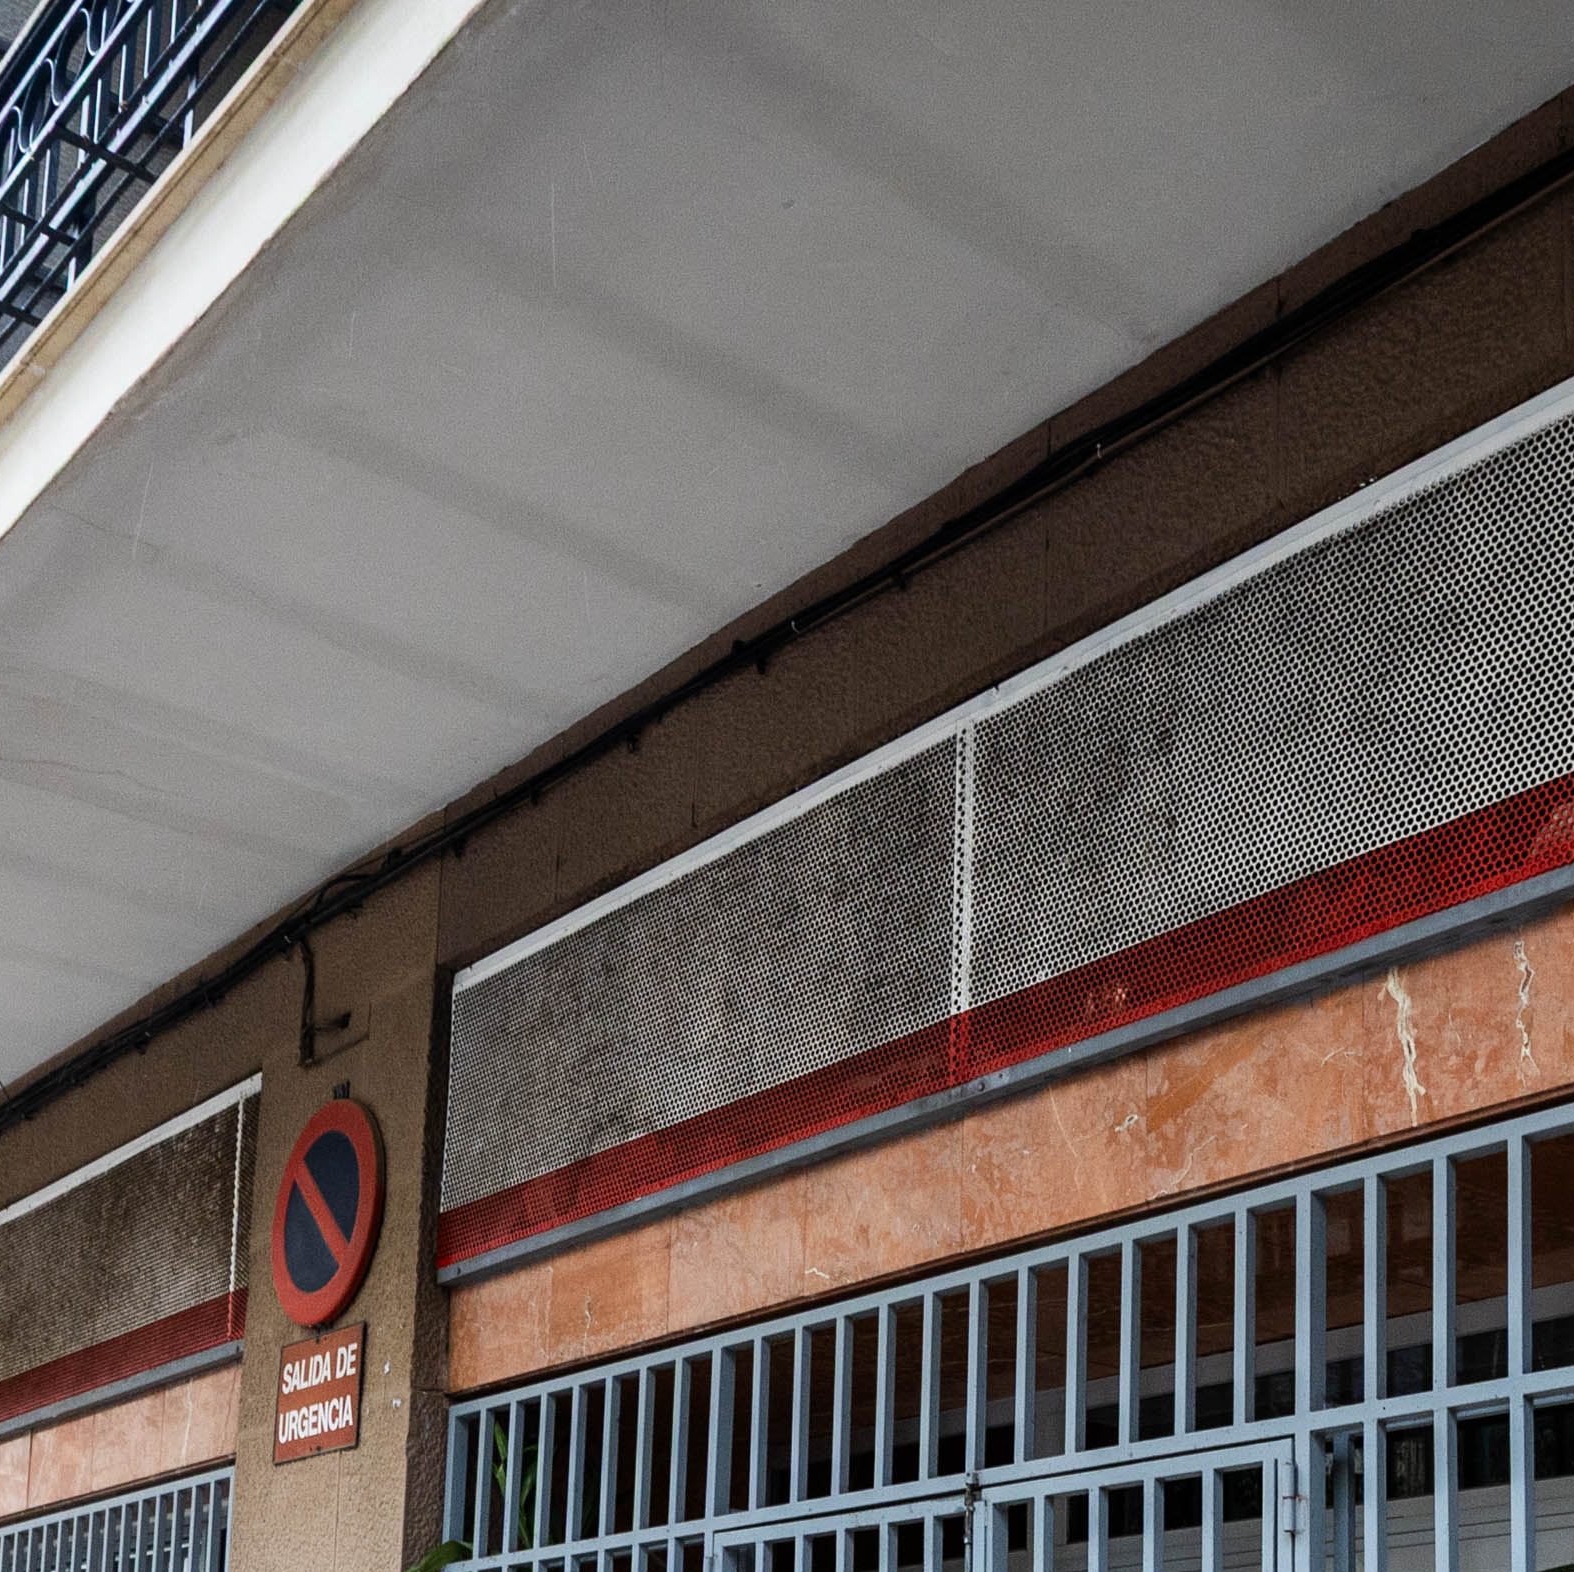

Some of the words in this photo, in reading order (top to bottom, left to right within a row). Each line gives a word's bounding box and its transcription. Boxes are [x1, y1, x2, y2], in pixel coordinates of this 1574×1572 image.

[282, 1350, 331, 1395] SALIDA
[335, 1343, 358, 1380] DE
[278, 1394, 354, 1445] URGENCIA
